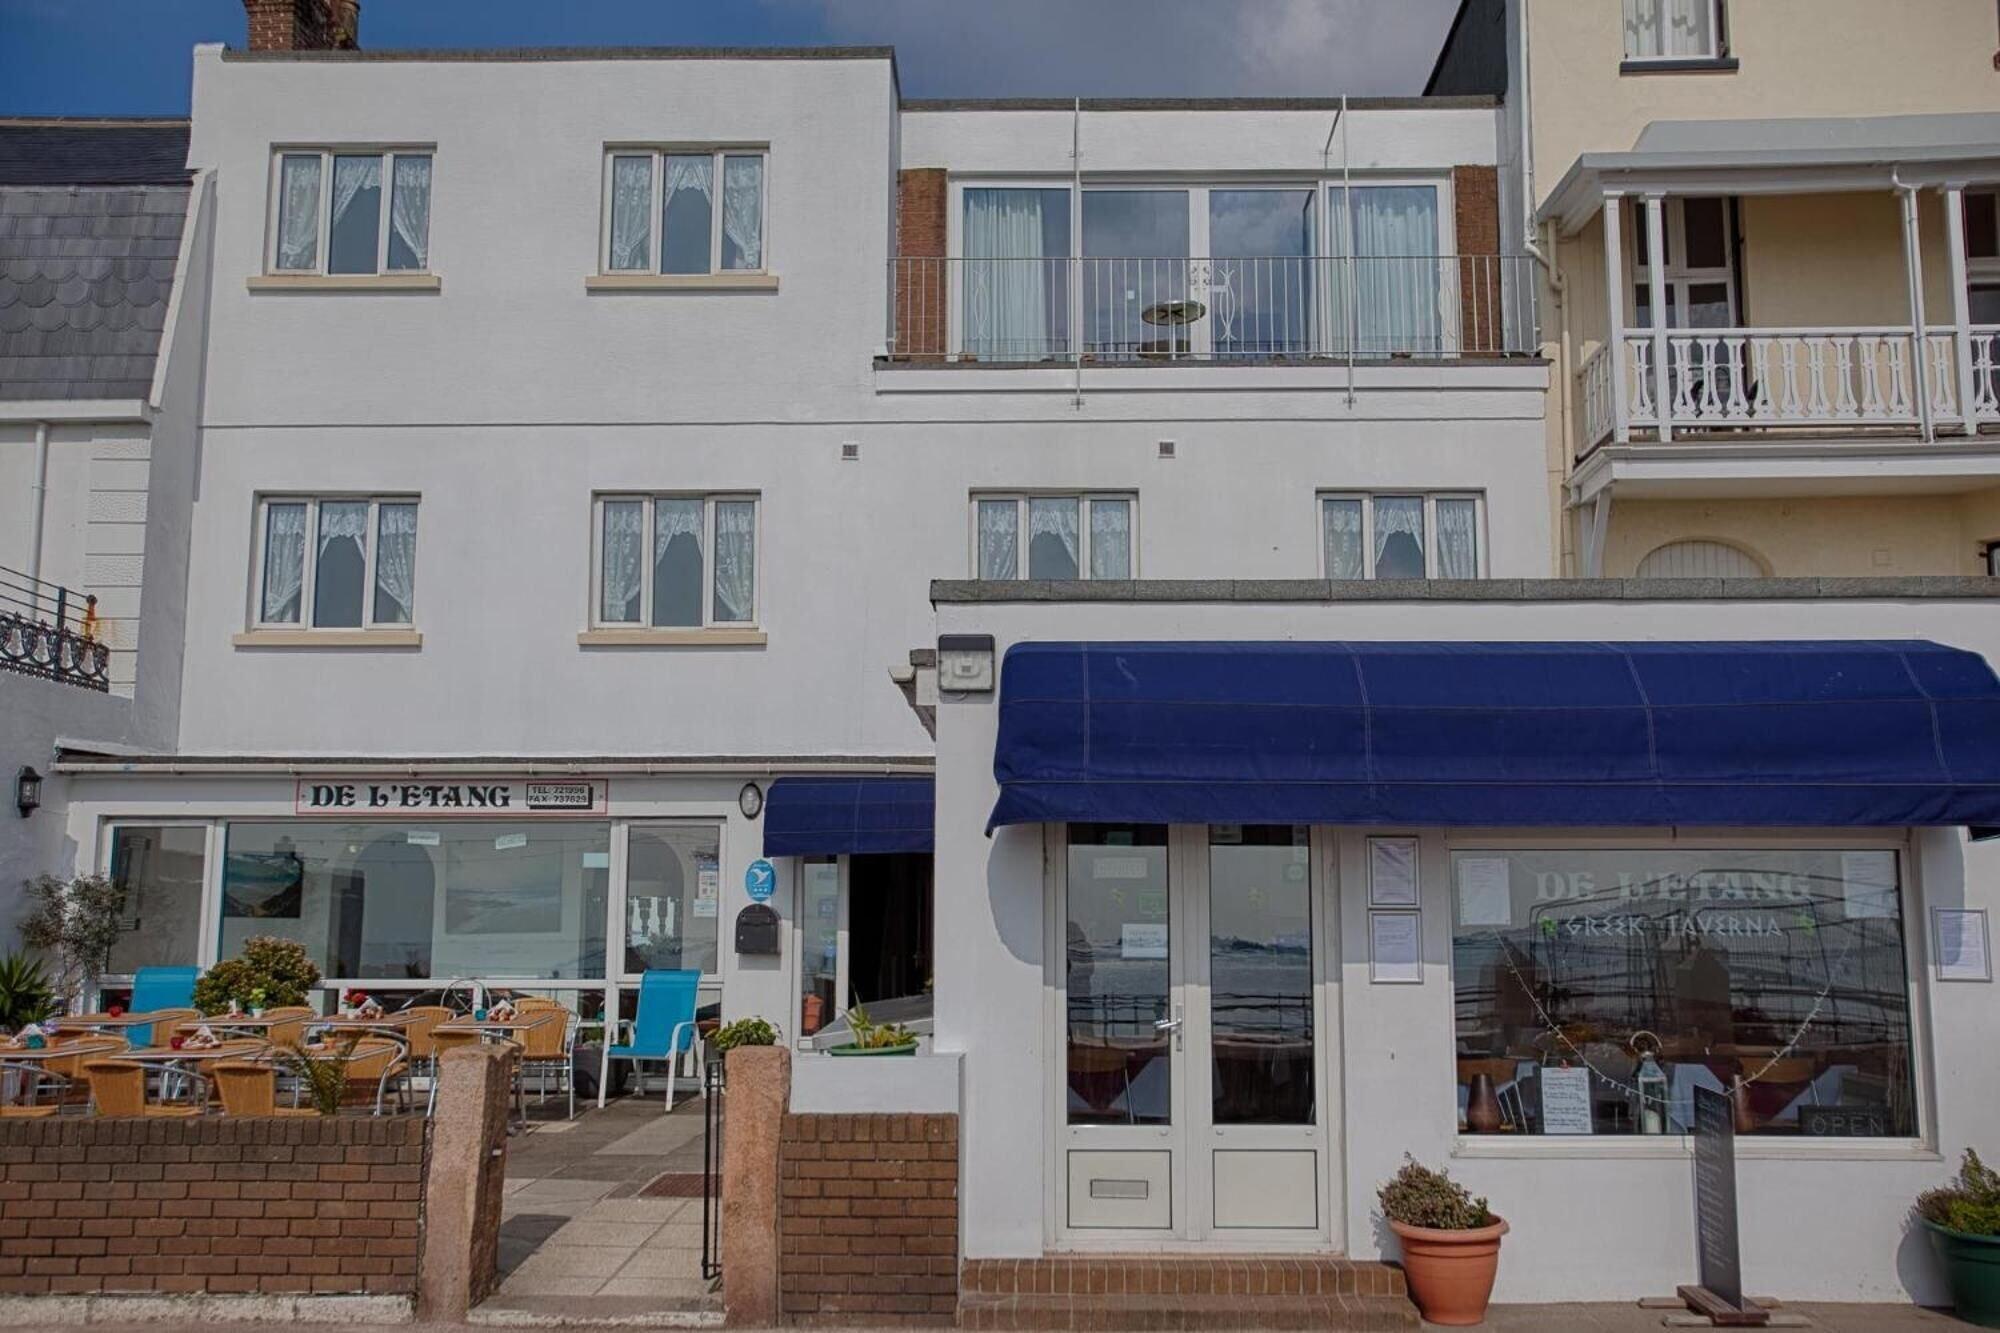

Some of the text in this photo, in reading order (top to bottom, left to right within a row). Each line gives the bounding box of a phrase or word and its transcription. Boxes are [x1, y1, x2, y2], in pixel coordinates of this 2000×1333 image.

[310, 785, 511, 807] DE L'ETANG
[1535, 871, 1595, 901] DE
[1618, 871, 1812, 901] L'ETANG
[1565, 915, 1783, 938] GREEK TAVERNA
[1811, 1116, 1884, 1136] OPEN
